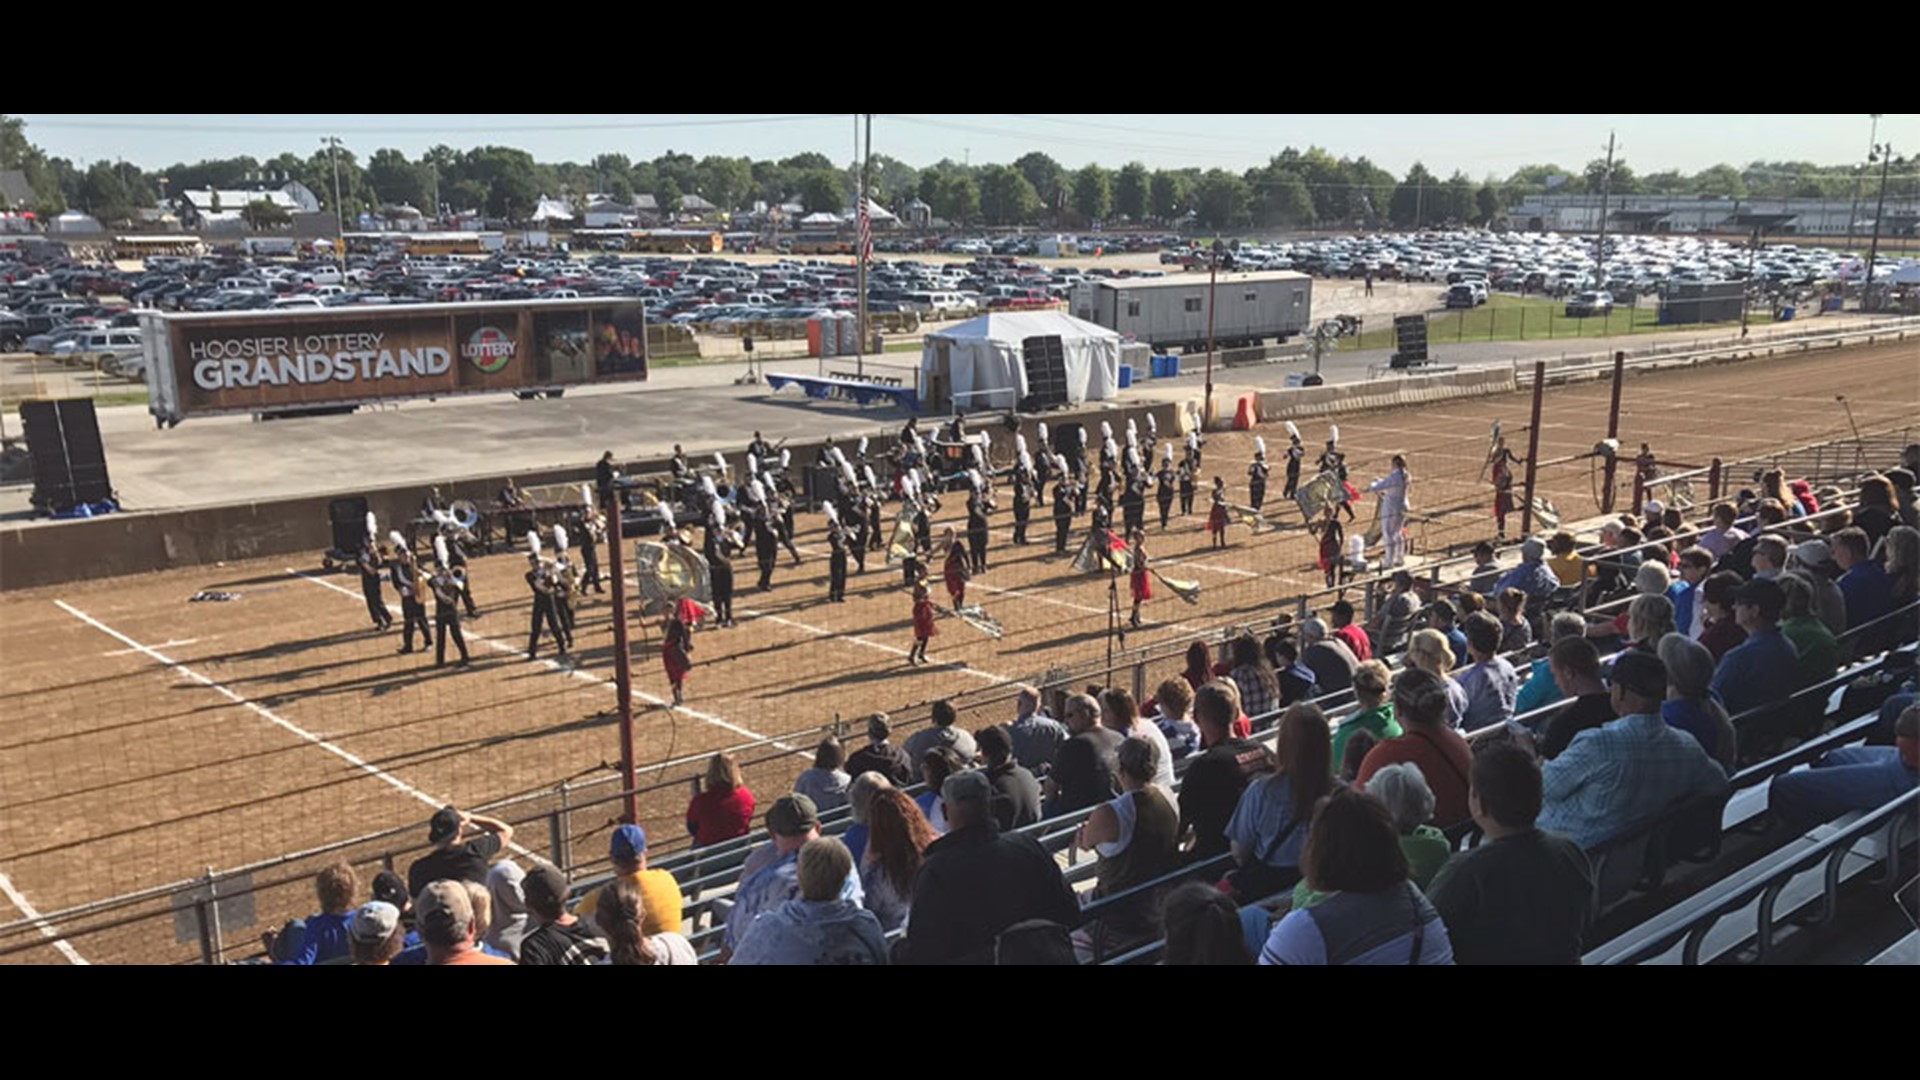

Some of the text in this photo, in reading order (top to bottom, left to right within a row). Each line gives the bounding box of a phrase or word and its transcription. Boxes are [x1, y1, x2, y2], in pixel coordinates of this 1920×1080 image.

[190, 332, 385, 359] HOOSIER LOTTERY
[461, 341, 516, 357] LOTTERY
[193, 347, 451, 389] GRANDSTAND
